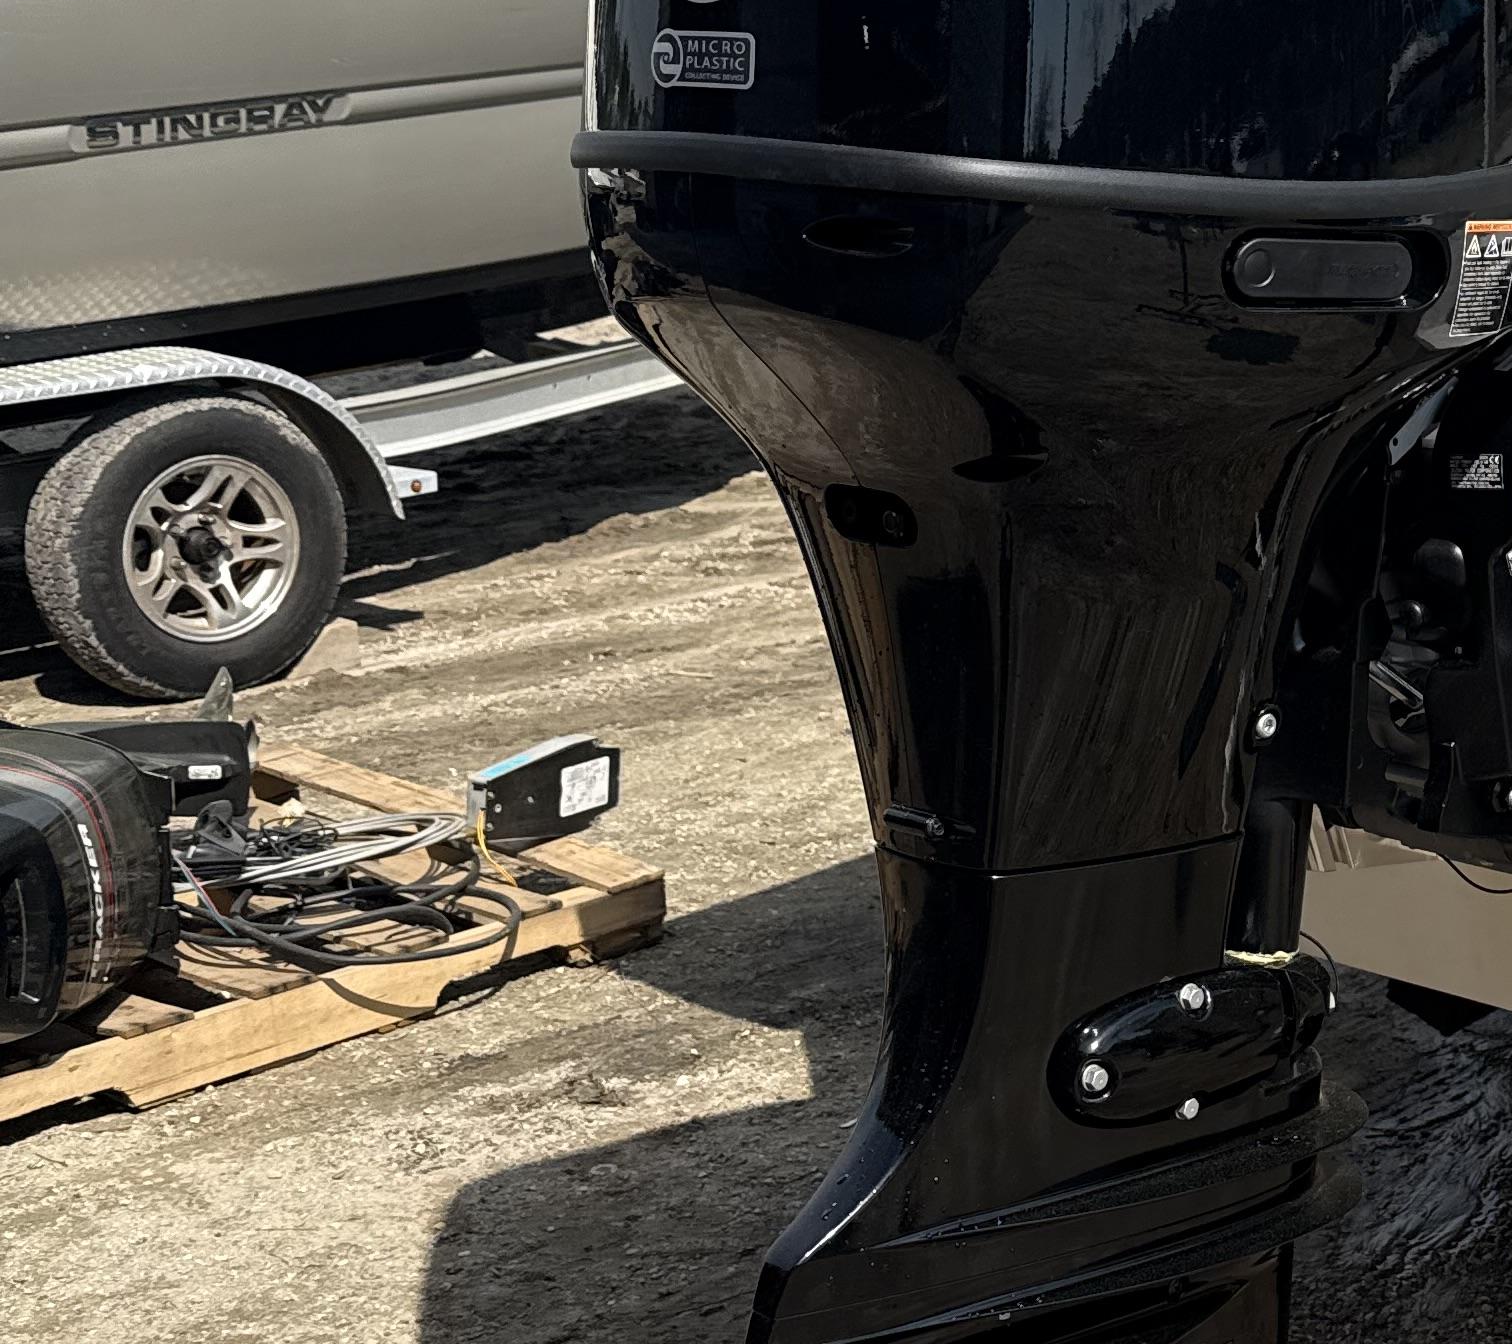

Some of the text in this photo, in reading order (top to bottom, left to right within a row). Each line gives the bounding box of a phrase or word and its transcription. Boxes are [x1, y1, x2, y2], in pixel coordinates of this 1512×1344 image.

[687, 39, 746, 55] MICRO
[685, 55, 745, 71] PLASTIC
[87, 94, 337, 149] STINGRAY
